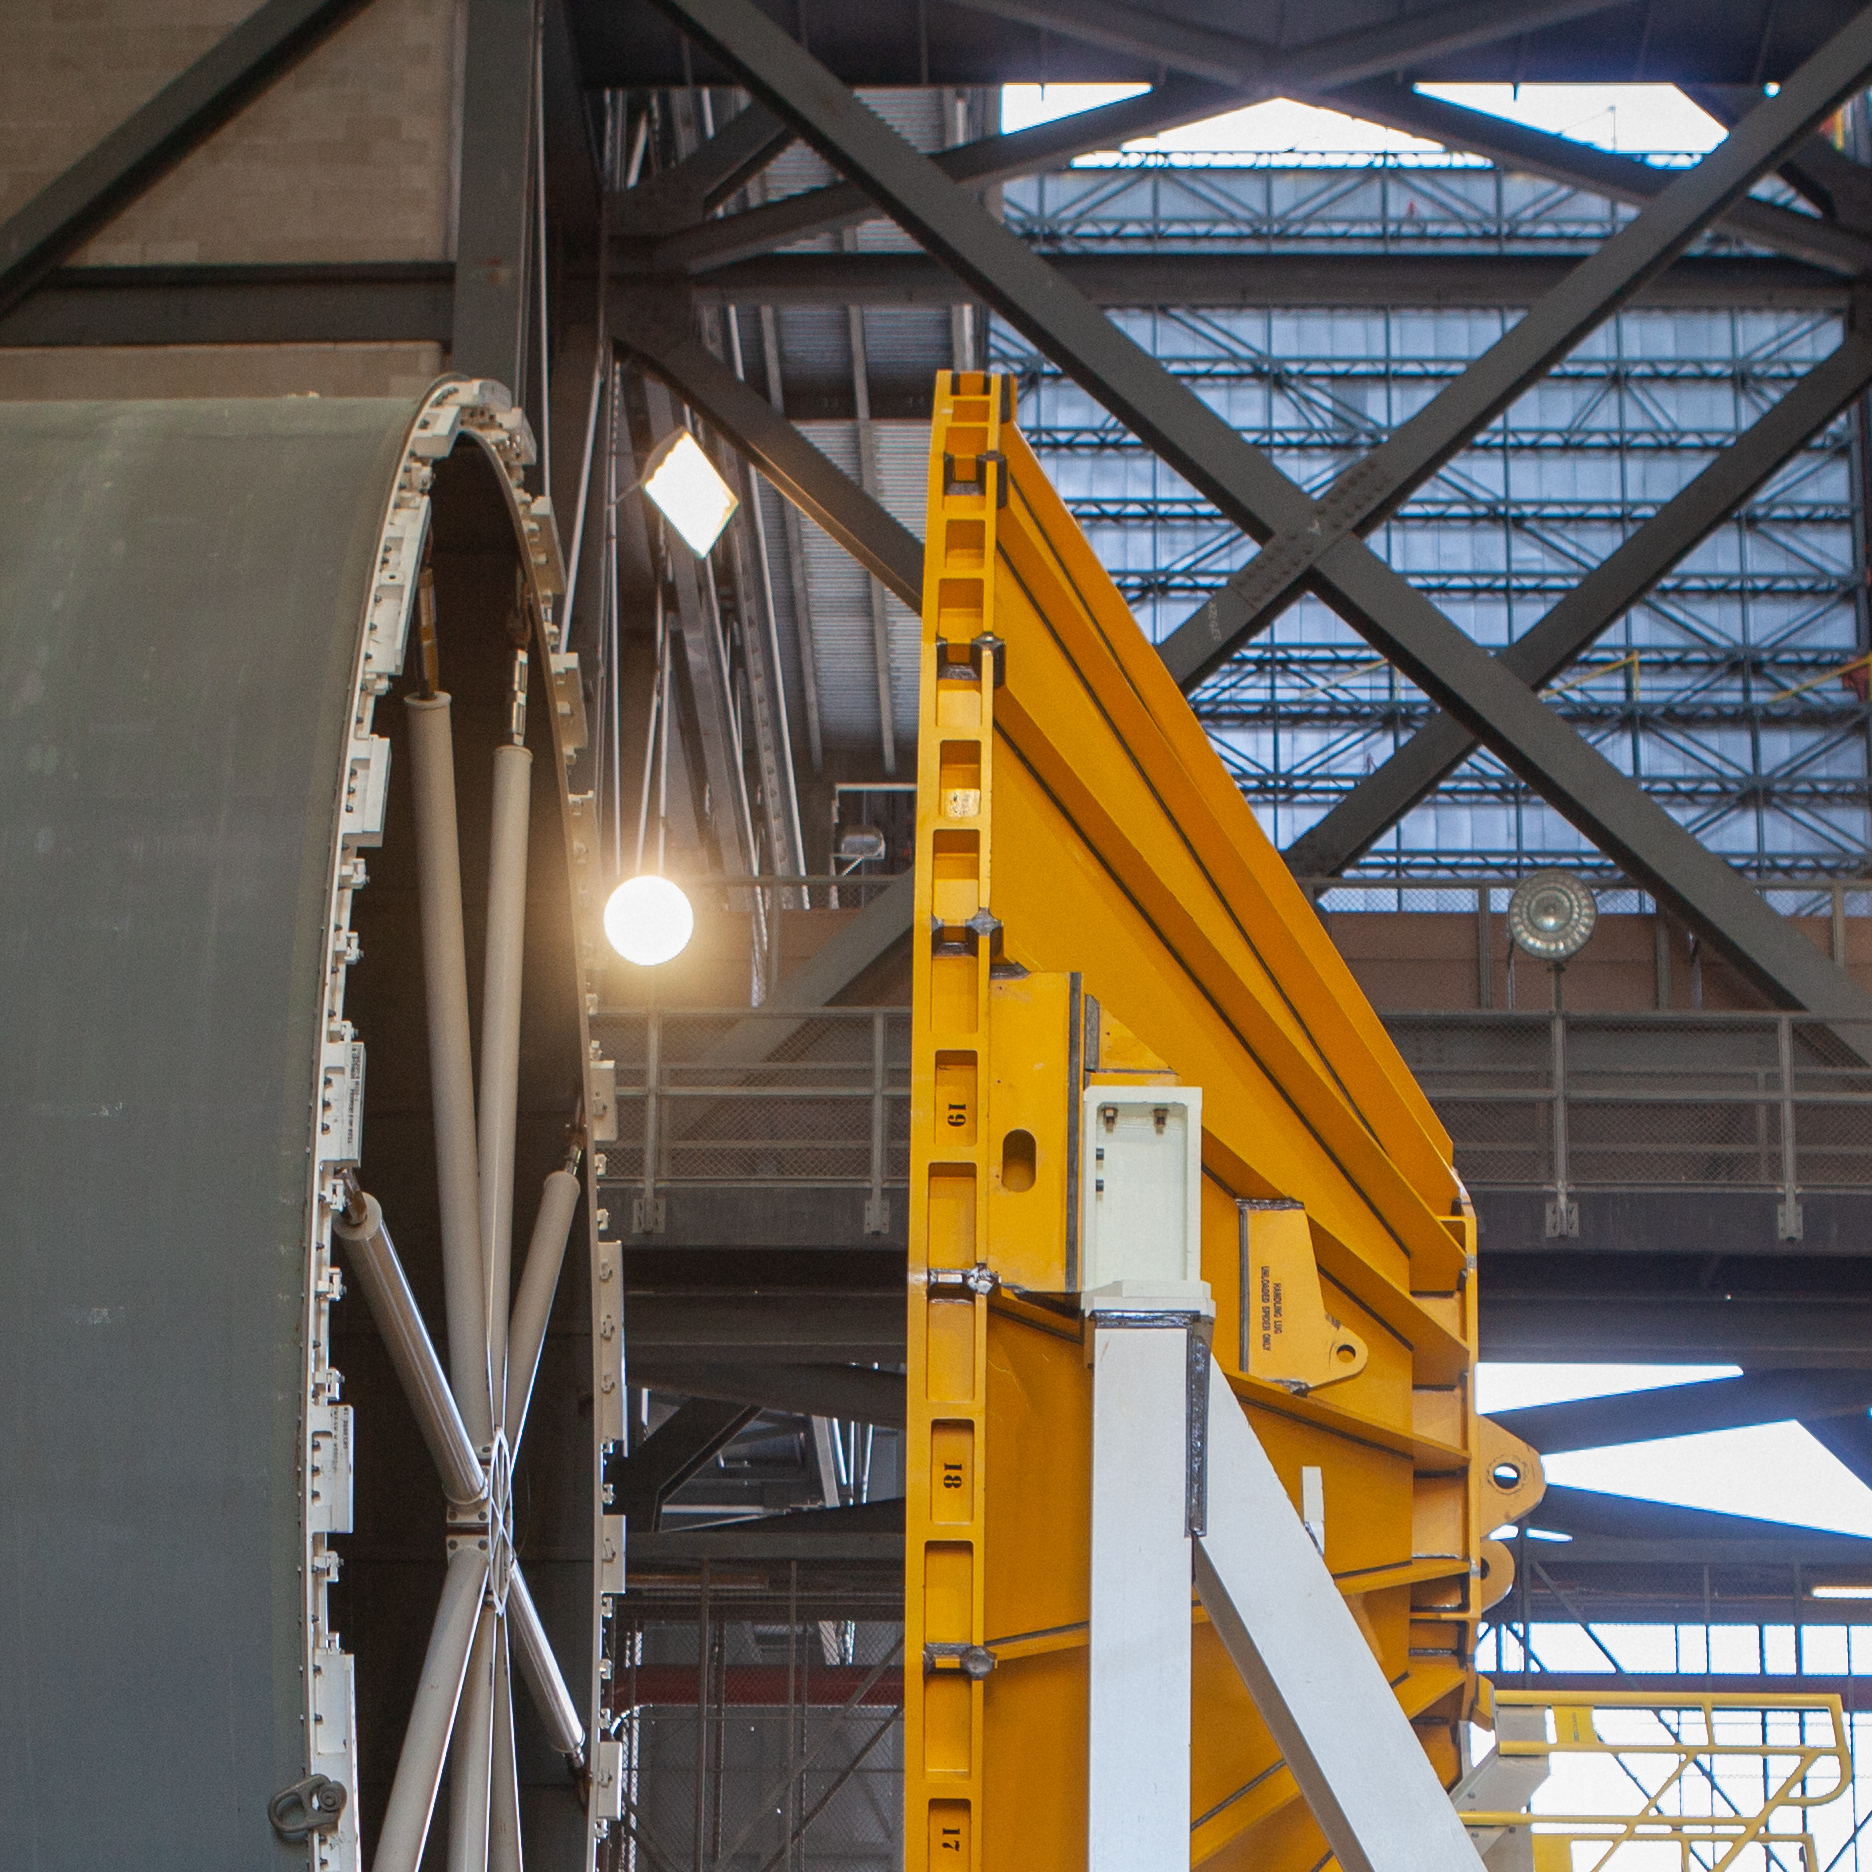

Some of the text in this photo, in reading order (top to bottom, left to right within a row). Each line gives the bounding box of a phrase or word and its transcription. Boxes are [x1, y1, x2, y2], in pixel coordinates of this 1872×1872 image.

[947, 1103, 967, 1127] 19
[1261, 1306, 1271, 1331] SPIDER
[1273, 1282, 1283, 1334] HANDLING LUG
[944, 1463, 963, 1488] 18
[942, 1828, 961, 1852] 17
